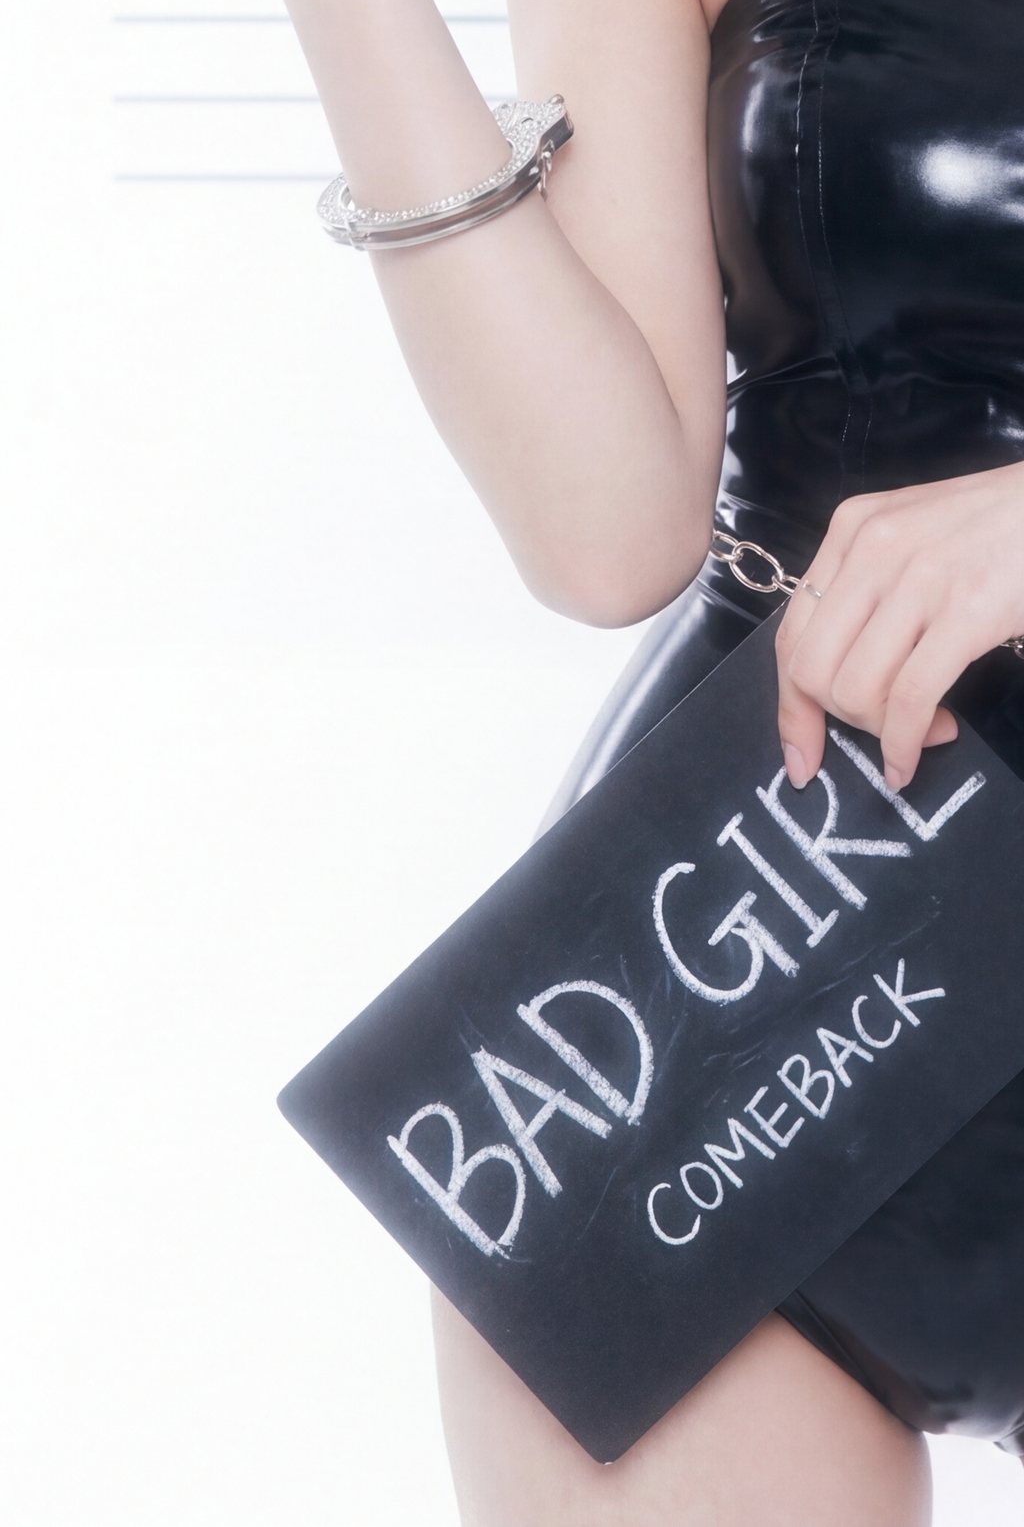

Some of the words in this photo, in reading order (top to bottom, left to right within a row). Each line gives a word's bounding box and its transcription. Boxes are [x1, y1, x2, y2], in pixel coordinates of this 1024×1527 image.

[388, 980, 655, 1257] BAD
[653, 728, 987, 1004] GIRL
[647, 959, 945, 1245] COMEBACK
